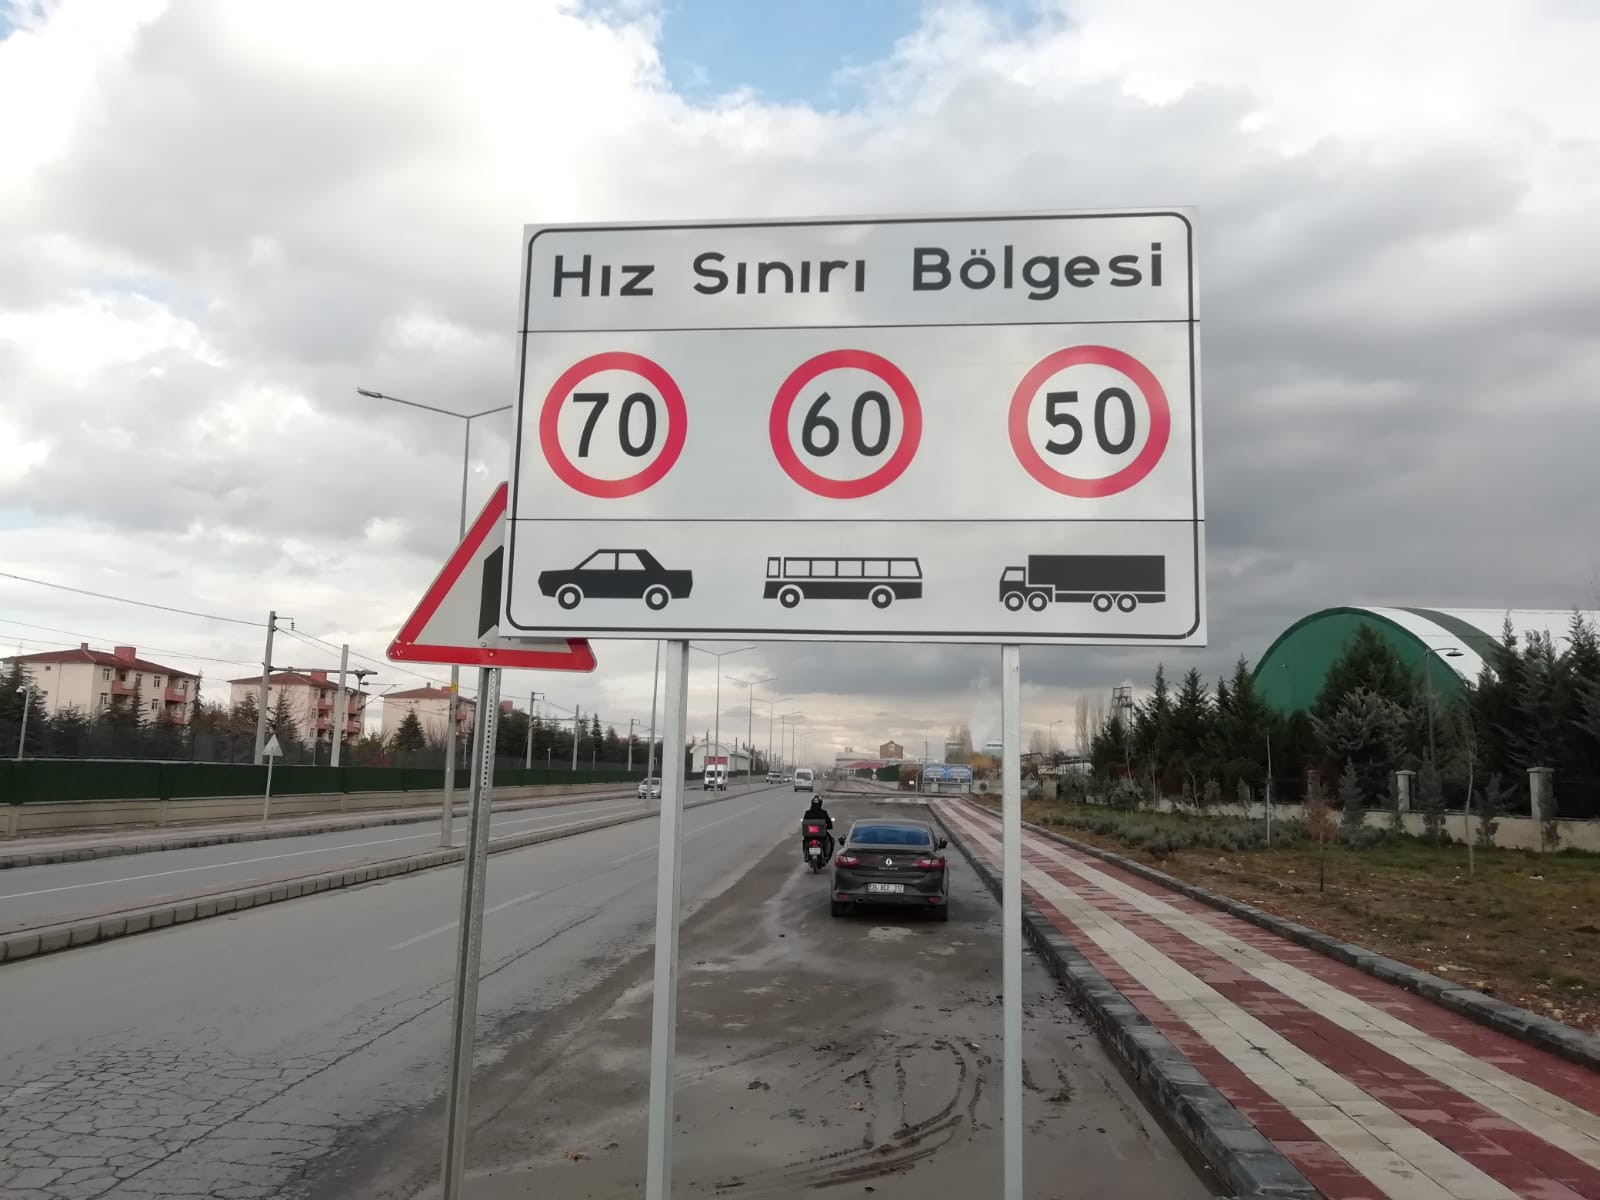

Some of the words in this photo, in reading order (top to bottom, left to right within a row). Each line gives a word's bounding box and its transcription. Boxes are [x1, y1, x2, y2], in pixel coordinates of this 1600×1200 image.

[553, 254, 655, 298] Hız
[693, 252, 865, 295] Sınırı
[913, 242, 1162, 301] Bölgesi
[572, 392, 657, 458] 70
[801, 390, 891, 457] 60
[1045, 387, 1136, 455] 50
